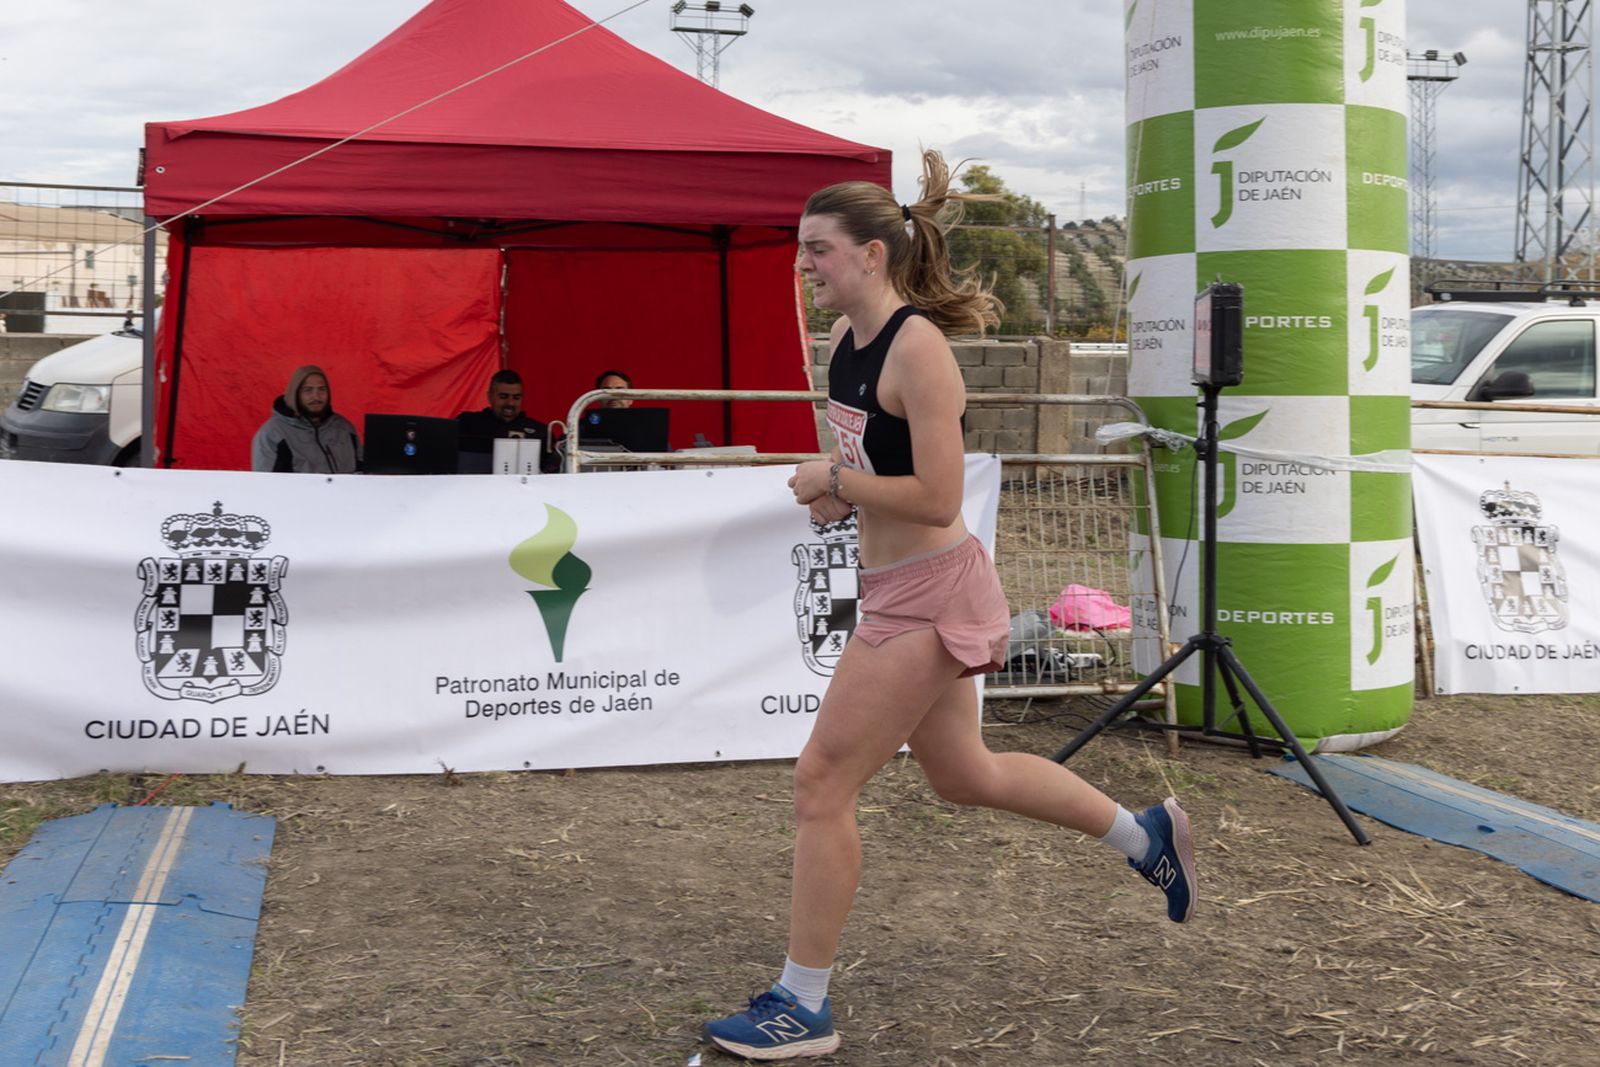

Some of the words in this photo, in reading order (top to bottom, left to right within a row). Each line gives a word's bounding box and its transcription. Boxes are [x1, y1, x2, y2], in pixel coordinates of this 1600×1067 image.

[1215, 26, 1321, 42] www.dipujaen.es
[1238, 169, 1332, 185] DIPUTACIÓN
[1239, 189, 1260, 201] DE
[1262, 186, 1302, 202] JAÉN
[1245, 315, 1332, 329] PORTES
[832, 425, 865, 469] 51
[1242, 481, 1263, 494] DE
[1266, 480, 1306, 494] JAÉN
[1217, 609, 1334, 625] DEPORTES
[1465, 644, 1531, 660] CIUDAD
[1535, 644, 1557, 659] DE
[435, 673, 540, 695] Patronato
[546, 669, 648, 693] Municipal
[654, 669, 681, 687] de
[464, 698, 562, 720] Deportes
[568, 696, 594, 715] de
[602, 692, 653, 713] Jaén
[761, 694, 820, 716] CIUD
[85, 718, 201, 739] CIUDAD
[210, 717, 248, 738] DE
[256, 709, 330, 737] JAÉN
